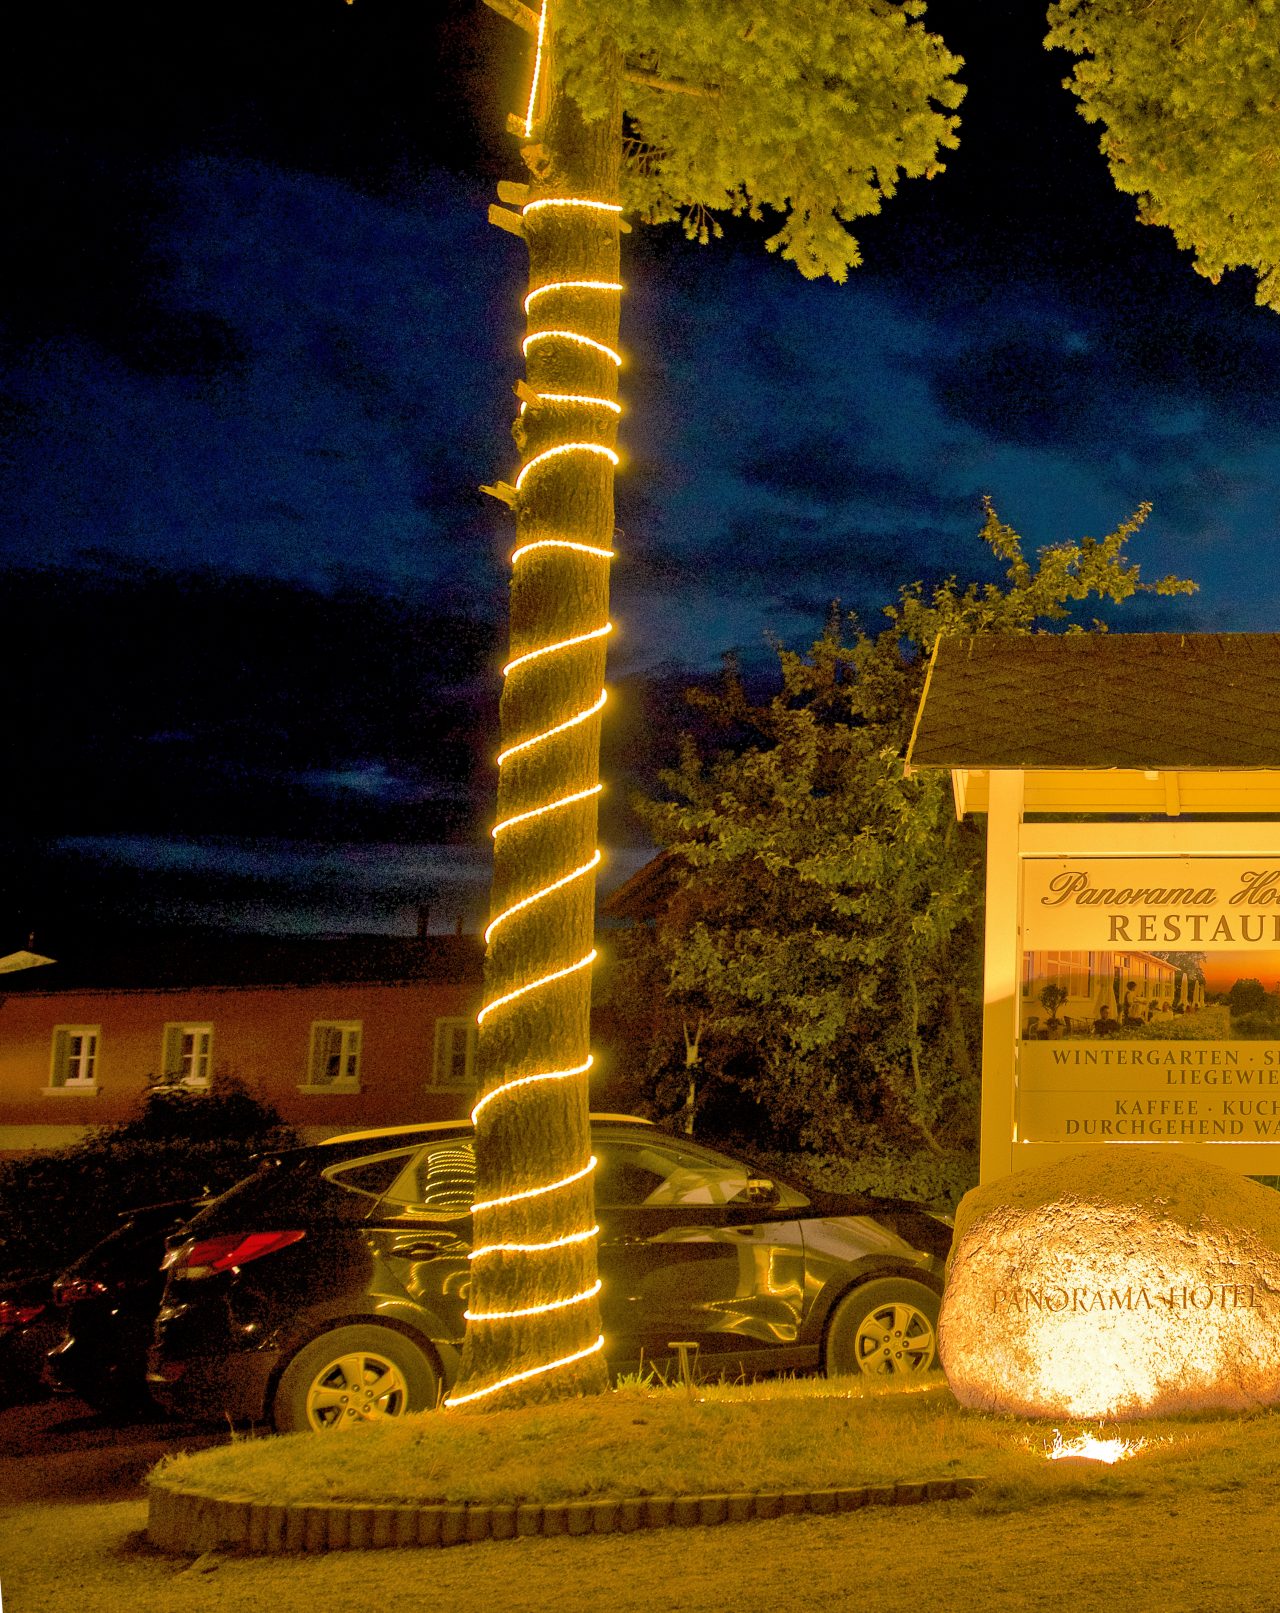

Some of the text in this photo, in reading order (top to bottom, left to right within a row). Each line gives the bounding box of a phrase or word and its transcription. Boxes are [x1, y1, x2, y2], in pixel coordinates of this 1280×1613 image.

[1041, 870, 1217, 906] Panorama
[1053, 1049, 1239, 1066] WINTERGARTEN
[1115, 1100, 1199, 1115] KAFFEE
[1066, 1119, 1244, 1135] DURCHGEHEND
[993, 1283, 1262, 1313] PANORAMA HOTEL
